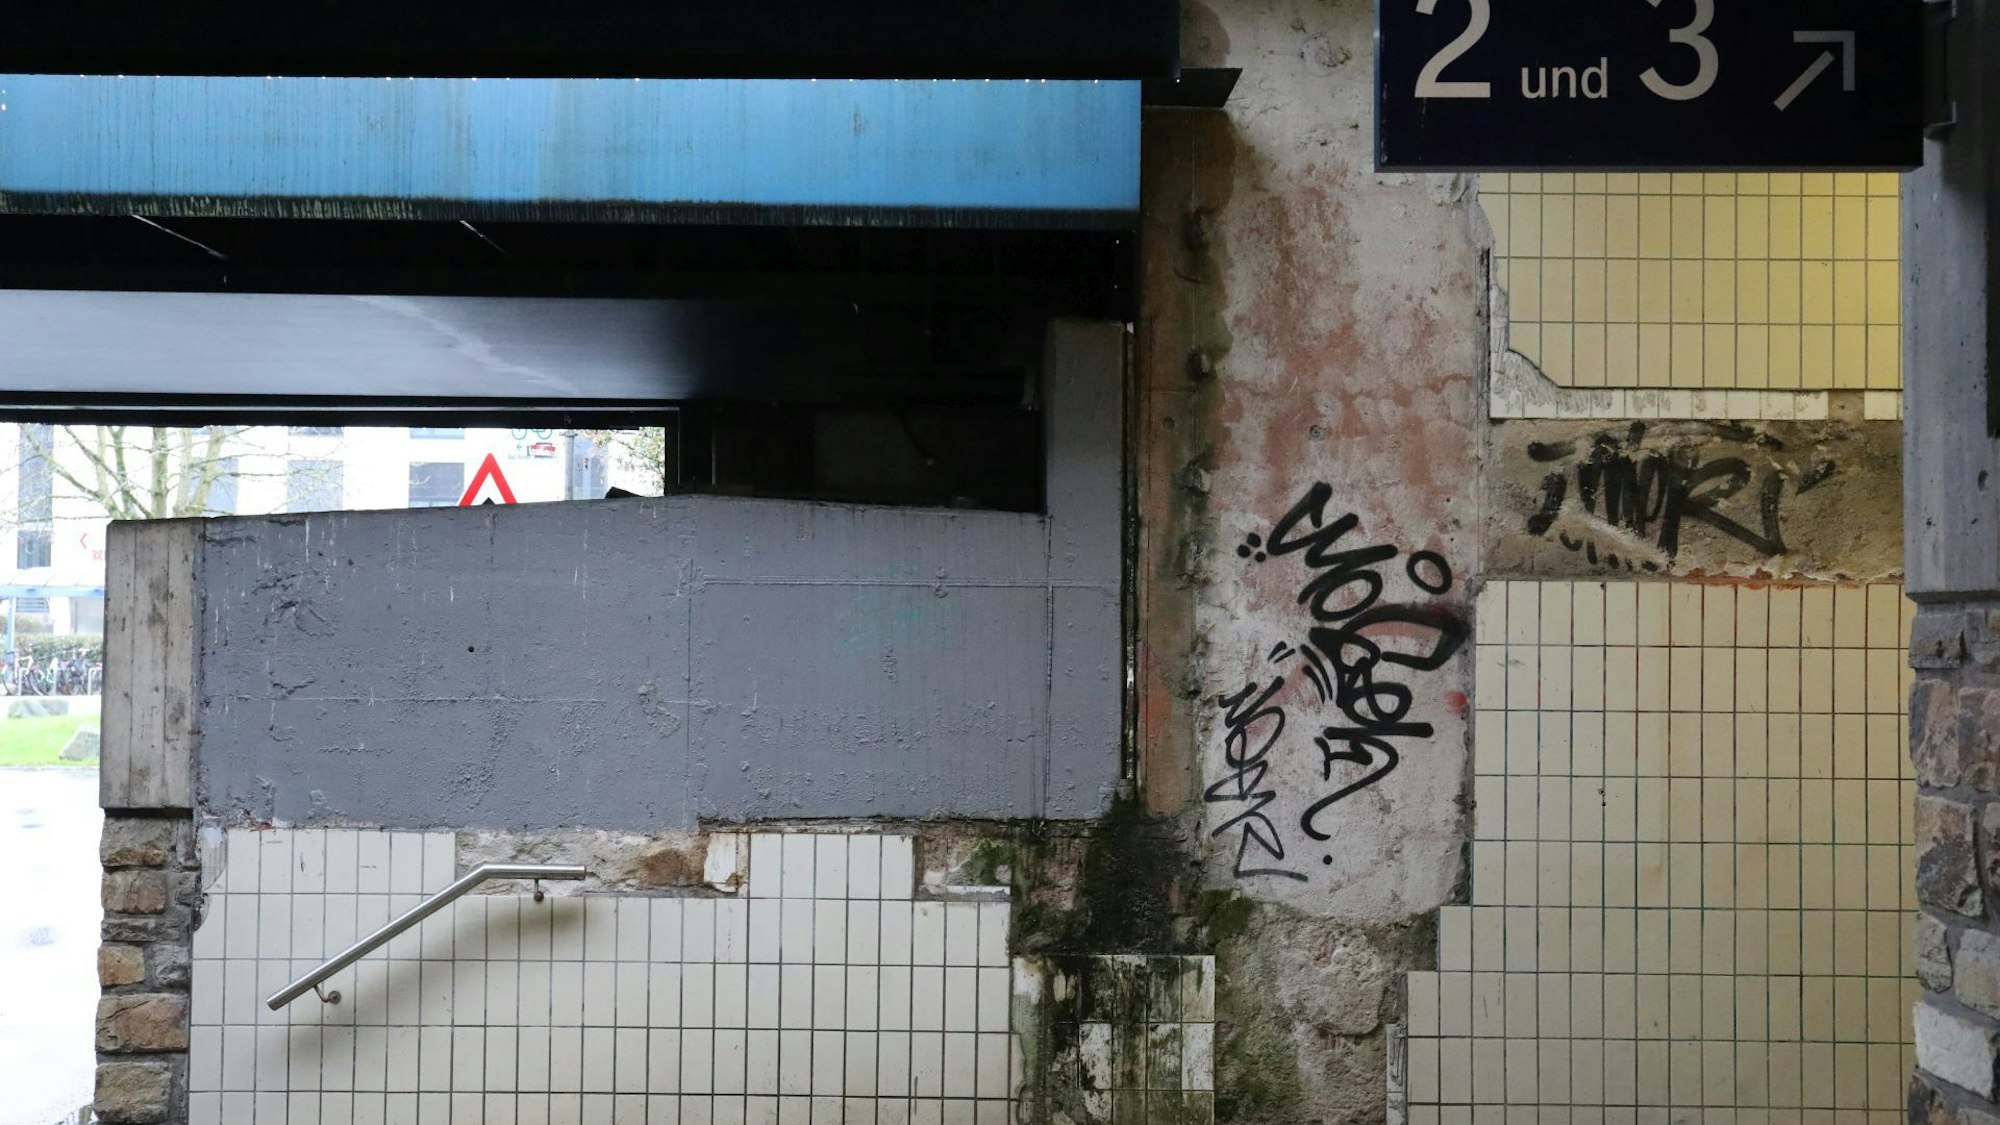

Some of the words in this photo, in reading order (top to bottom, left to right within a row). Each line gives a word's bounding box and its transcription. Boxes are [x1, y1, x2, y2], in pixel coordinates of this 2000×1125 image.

[1415, 0, 1491, 99] 2
[1521, 57, 1608, 99] und
[1639, 0, 1719, 100] 3
